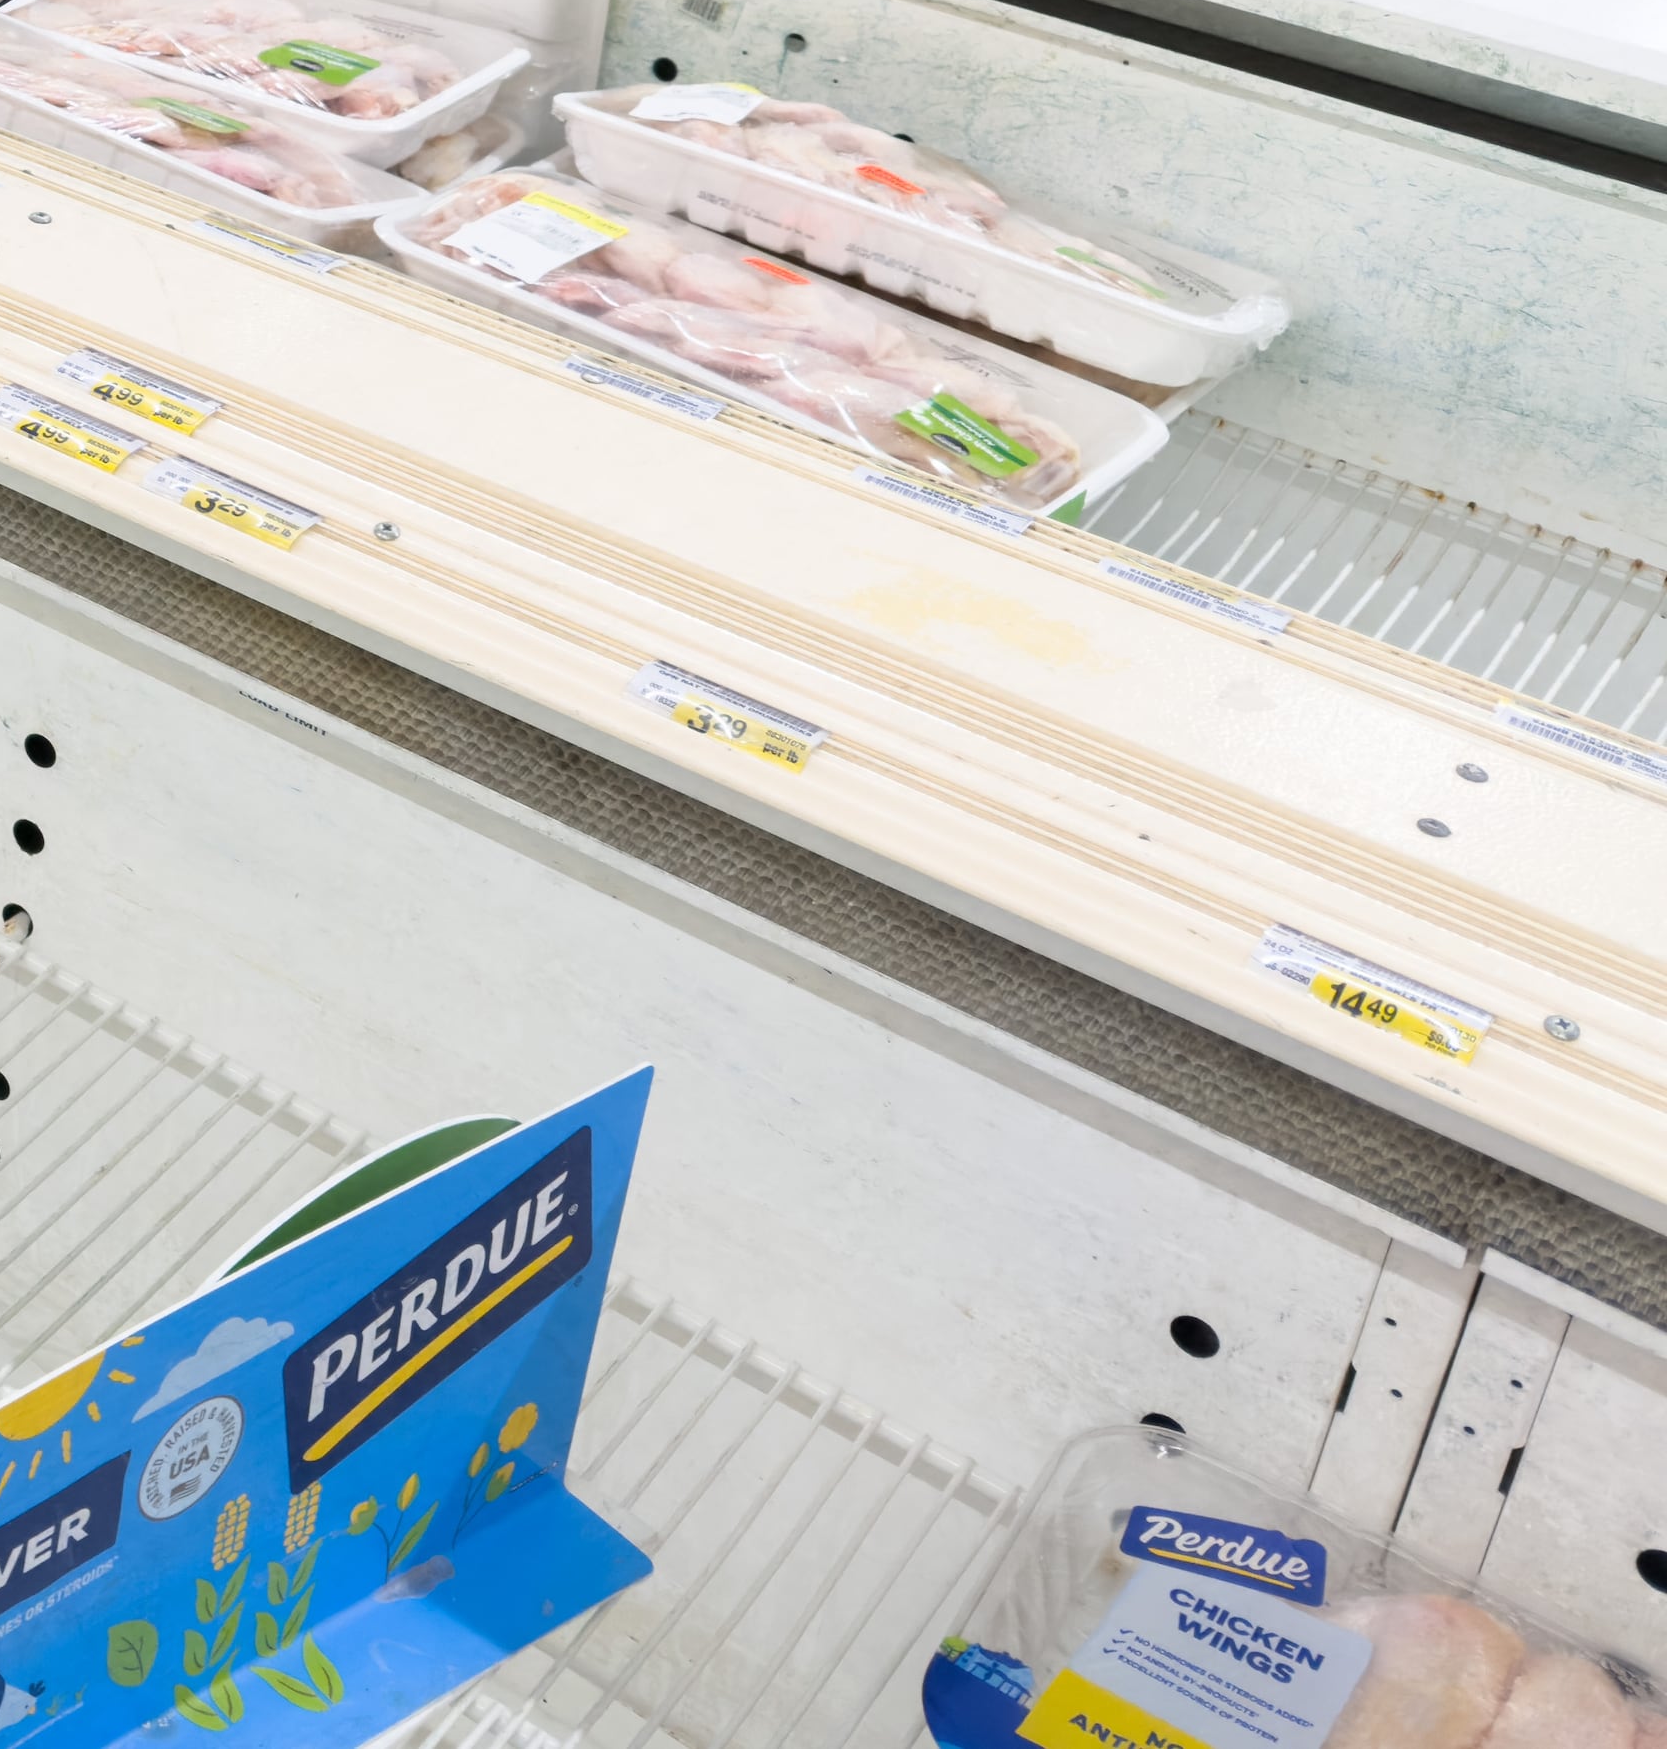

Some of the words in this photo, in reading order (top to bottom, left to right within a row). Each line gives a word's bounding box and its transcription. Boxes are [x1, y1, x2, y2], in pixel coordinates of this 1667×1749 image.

[785, 751, 798, 764] lb
[308, 1170, 568, 1423] PERDUE
[165, 1408, 207, 1449] RAISED
[190, 1431, 209, 1446] THE
[169, 1444, 210, 1480] USA
[1139, 1515, 1312, 1583] Perdue
[24, 1602, 43, 1621] OR
[1169, 1588, 1326, 1671] CHICKEN
[1143, 1650, 1181, 1682] ANIMAL
[1176, 1613, 1297, 1685] WINGS
[1117, 1655, 1175, 1692] EXCELLENT
[1175, 1685, 1219, 1715] SOURCE
[1219, 1708, 1234, 1722] OF
[1234, 1716, 1279, 1744] PROTEIN
[1150, 1641, 1208, 1678] HORMONES
[1223, 1678, 1275, 1713] STEROIDS
